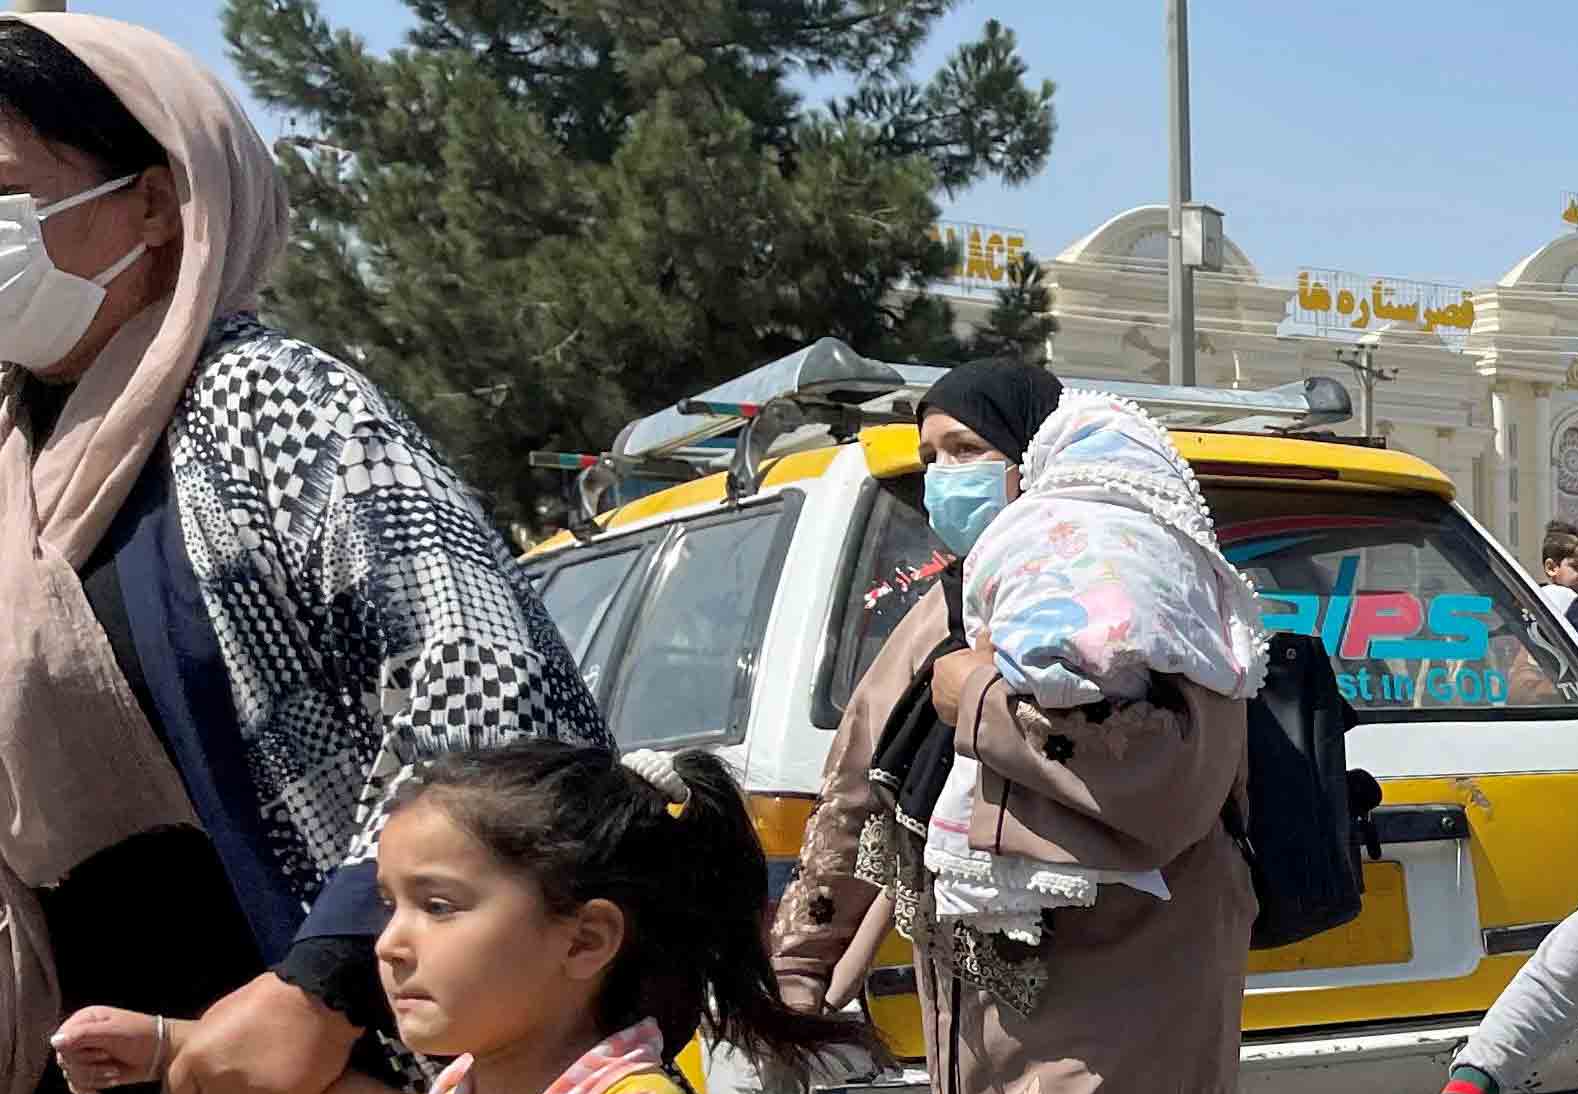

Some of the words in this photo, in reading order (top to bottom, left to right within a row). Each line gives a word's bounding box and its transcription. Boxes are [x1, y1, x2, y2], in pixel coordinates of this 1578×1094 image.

[1423, 290, 1475, 333] قصر
[1381, 670, 1415, 701] in
[1426, 666, 1508, 705] GOD
